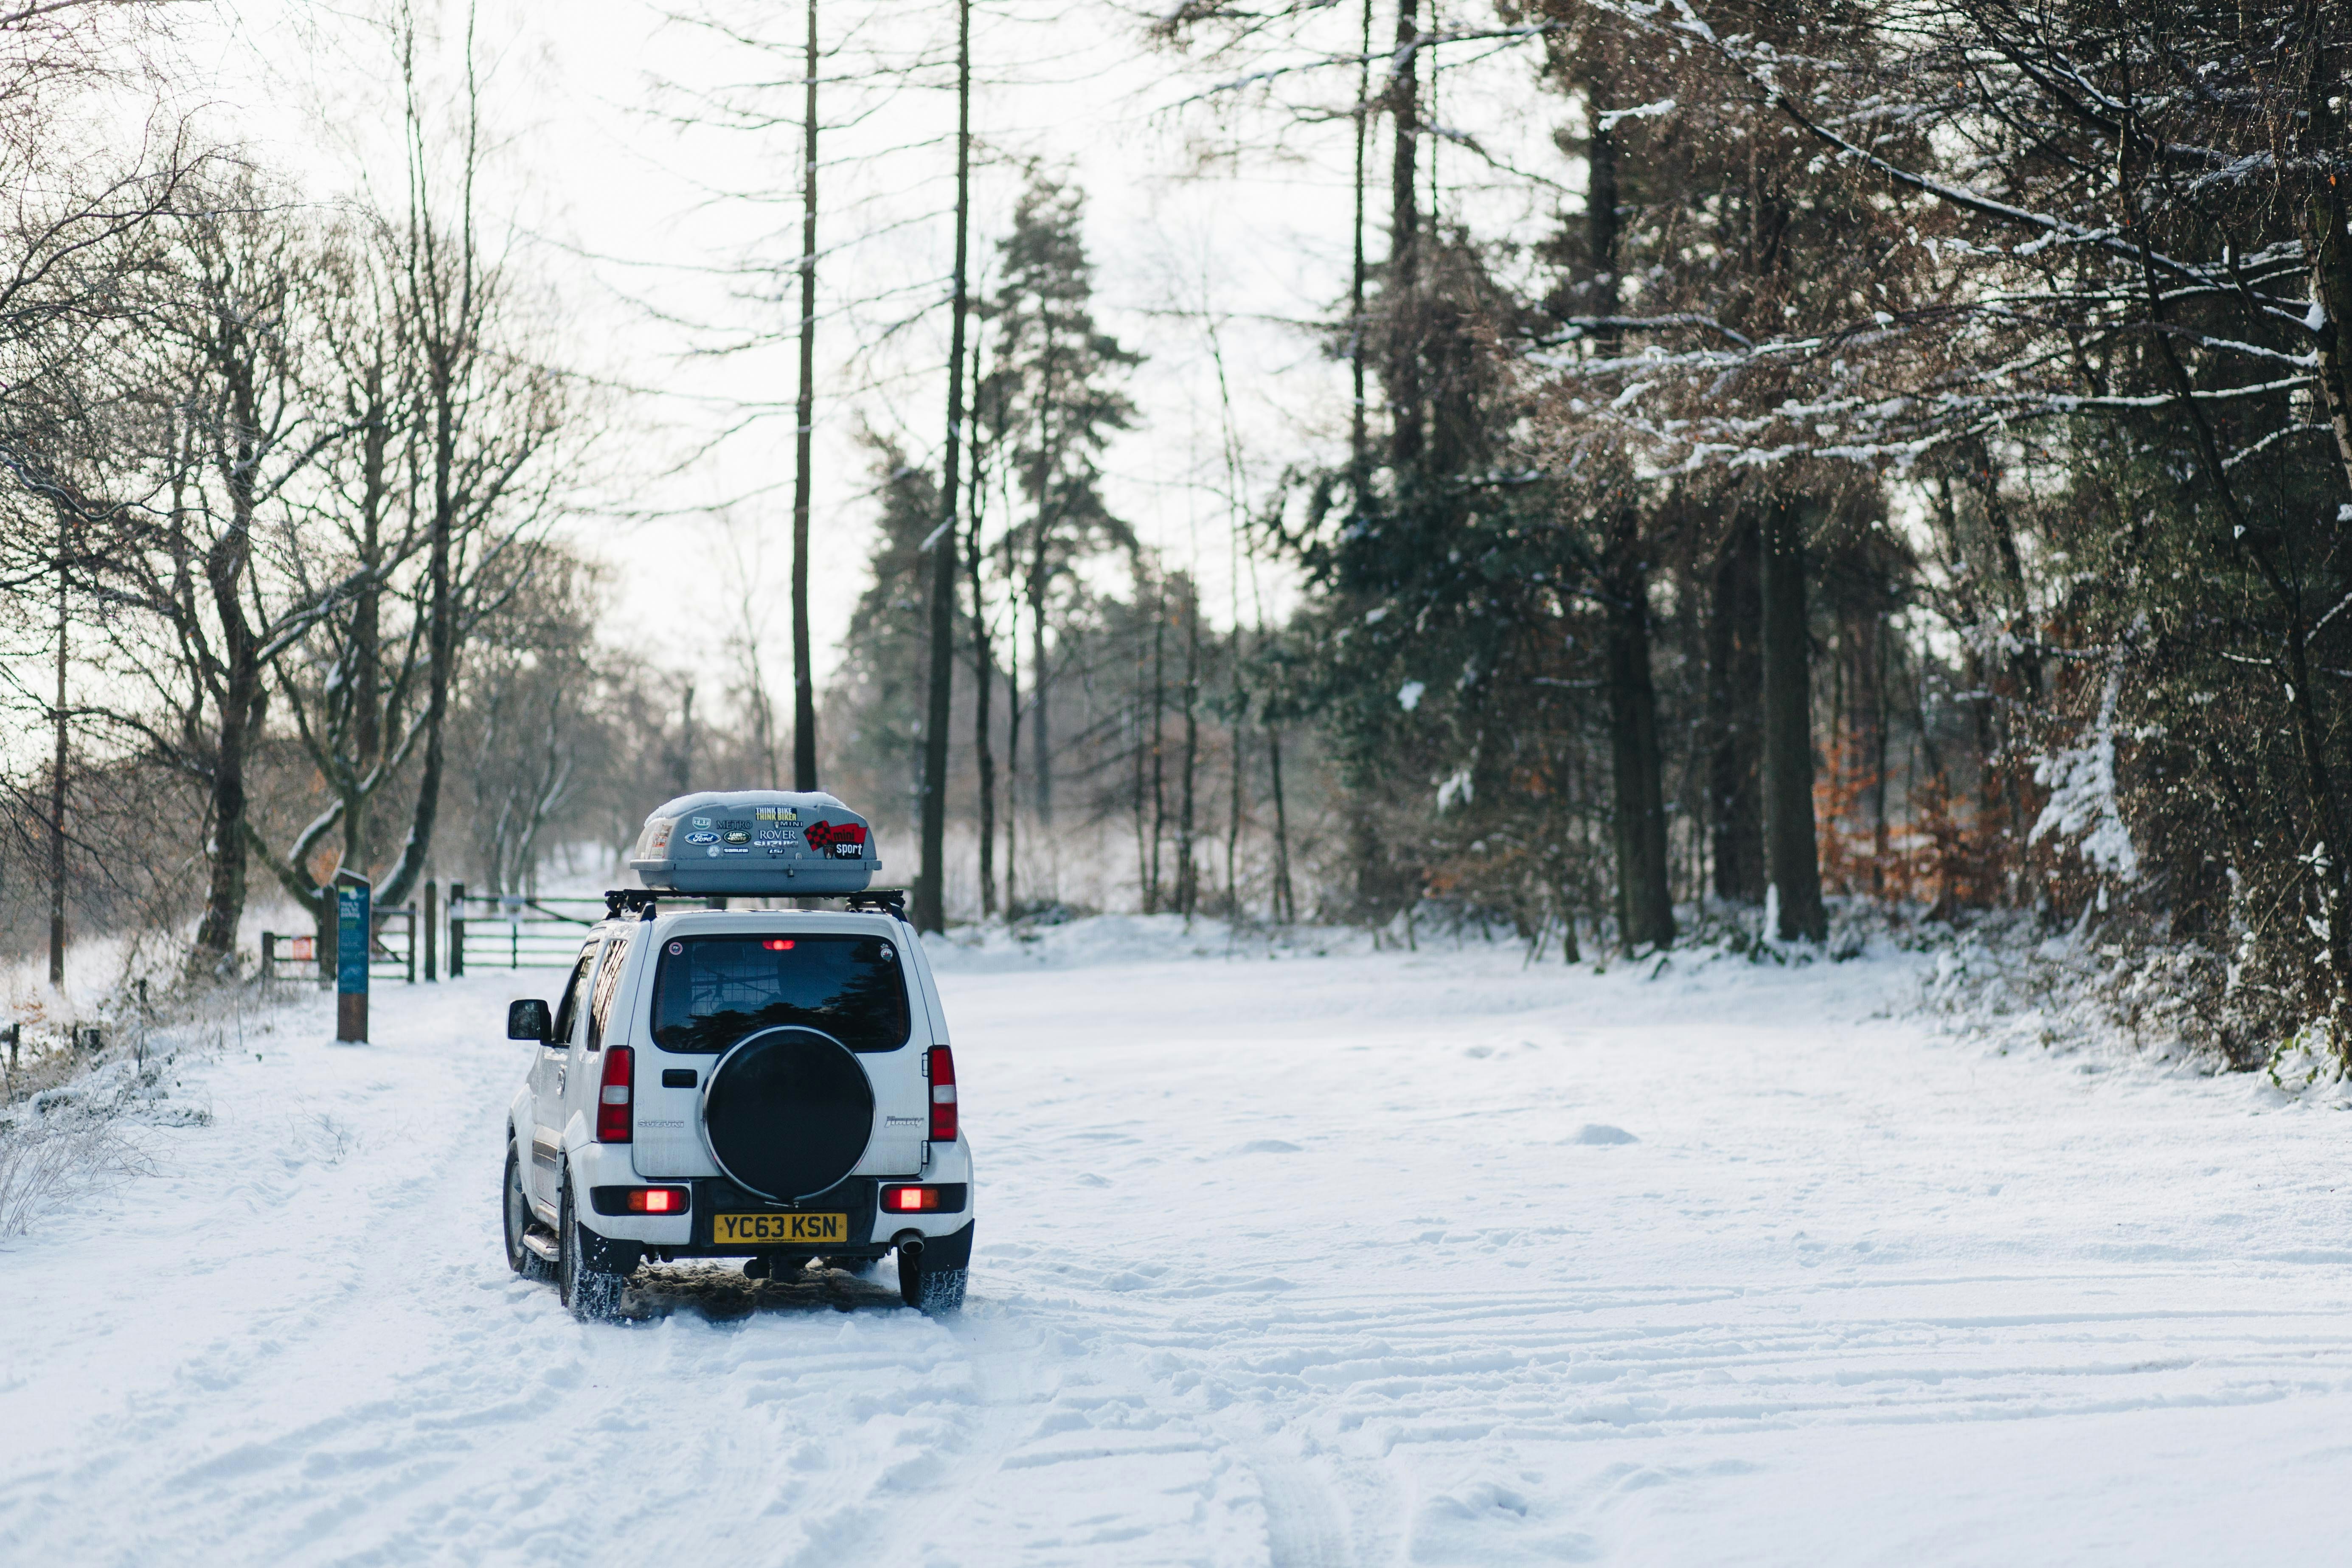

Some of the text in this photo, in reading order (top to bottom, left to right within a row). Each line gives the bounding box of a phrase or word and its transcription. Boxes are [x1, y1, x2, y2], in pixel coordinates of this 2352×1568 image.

[717, 820, 753, 829] METRO
[692, 833, 714, 842] Ford
[759, 830, 797, 840] ROVER
[833, 829, 854, 841] mini
[836, 843, 863, 856] sport
[638, 1119, 684, 1128] SUZUKI
[724, 1216, 837, 1238] YC63 KSN
